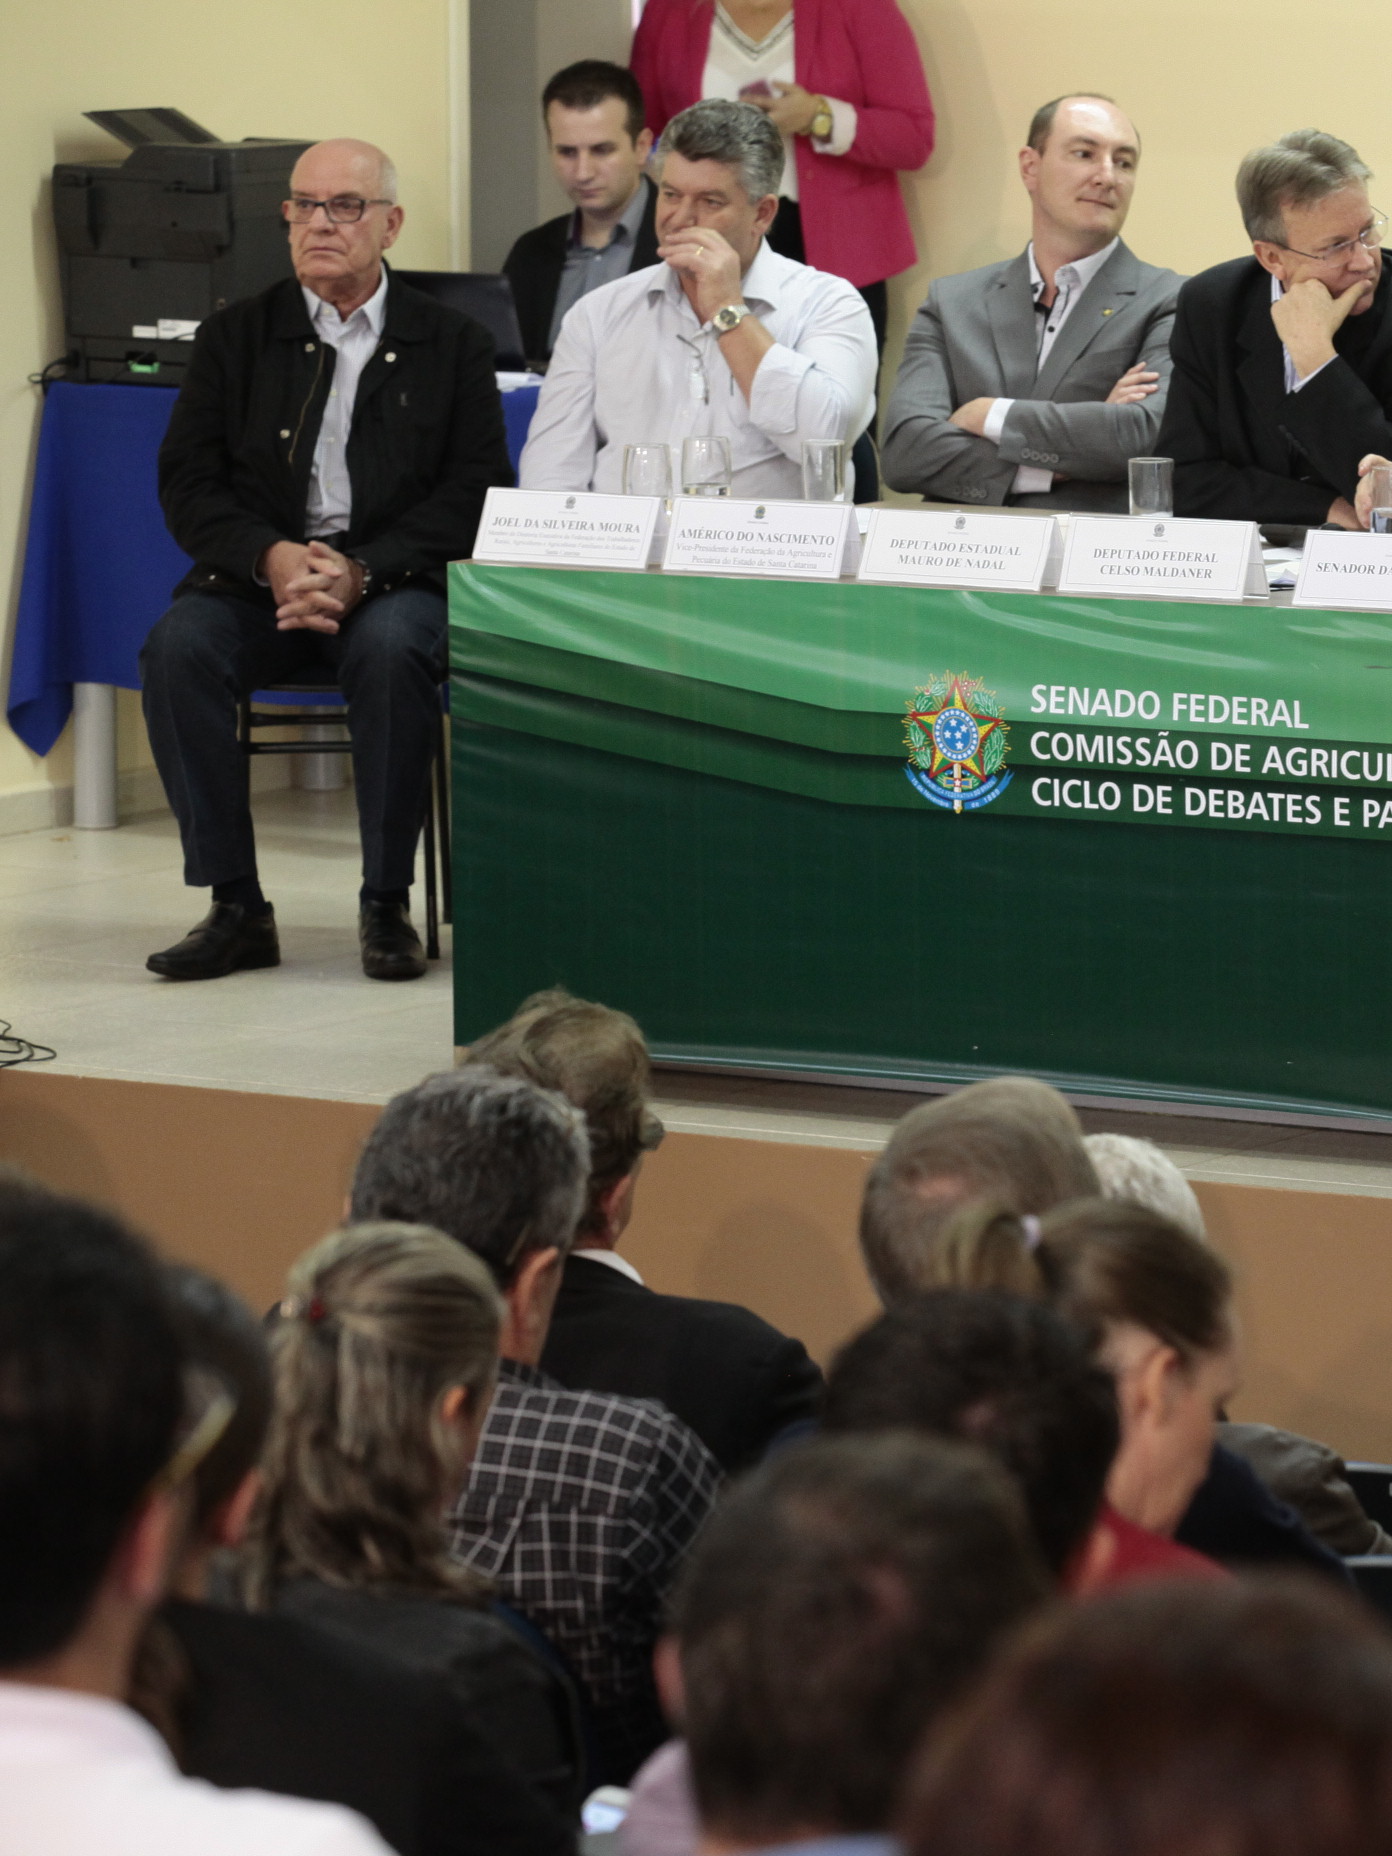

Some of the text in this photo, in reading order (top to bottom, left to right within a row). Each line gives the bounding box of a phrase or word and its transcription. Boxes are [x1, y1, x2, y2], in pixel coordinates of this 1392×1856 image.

[492, 516, 640, 533] JOEL DA SILVEIRA MOURA
[678, 527, 834, 546] AMÉRICO DO NASCIMENTO
[676, 543, 728, 553] Vice-Presidente
[730, 546, 739, 554] da
[740, 546, 775, 556] Federação
[777, 548, 786, 556] da
[788, 549, 826, 559] Agricultura
[890, 538, 1022, 556] DEPUTADO ESTADUAL
[692, 555, 817, 569] Pecuária do Estado de Santa Catarina
[898, 554, 1005, 570] MAURO DE NADAL
[1094, 548, 1218, 563] DEPUTADO FEDERAL
[1100, 564, 1212, 579] CELSO MALDANER
[1316, 562, 1376, 575] SENADOR
[1030, 684, 1310, 730] SENADO FEDERAL
[1030, 731, 1200, 770] COMISSÃO
[1211, 742, 1251, 774] DE
[1031, 777, 1121, 812] CICLO
[1133, 783, 1172, 814] DE
[1184, 786, 1322, 826] DEBATES
[1333, 796, 1350, 827] E
